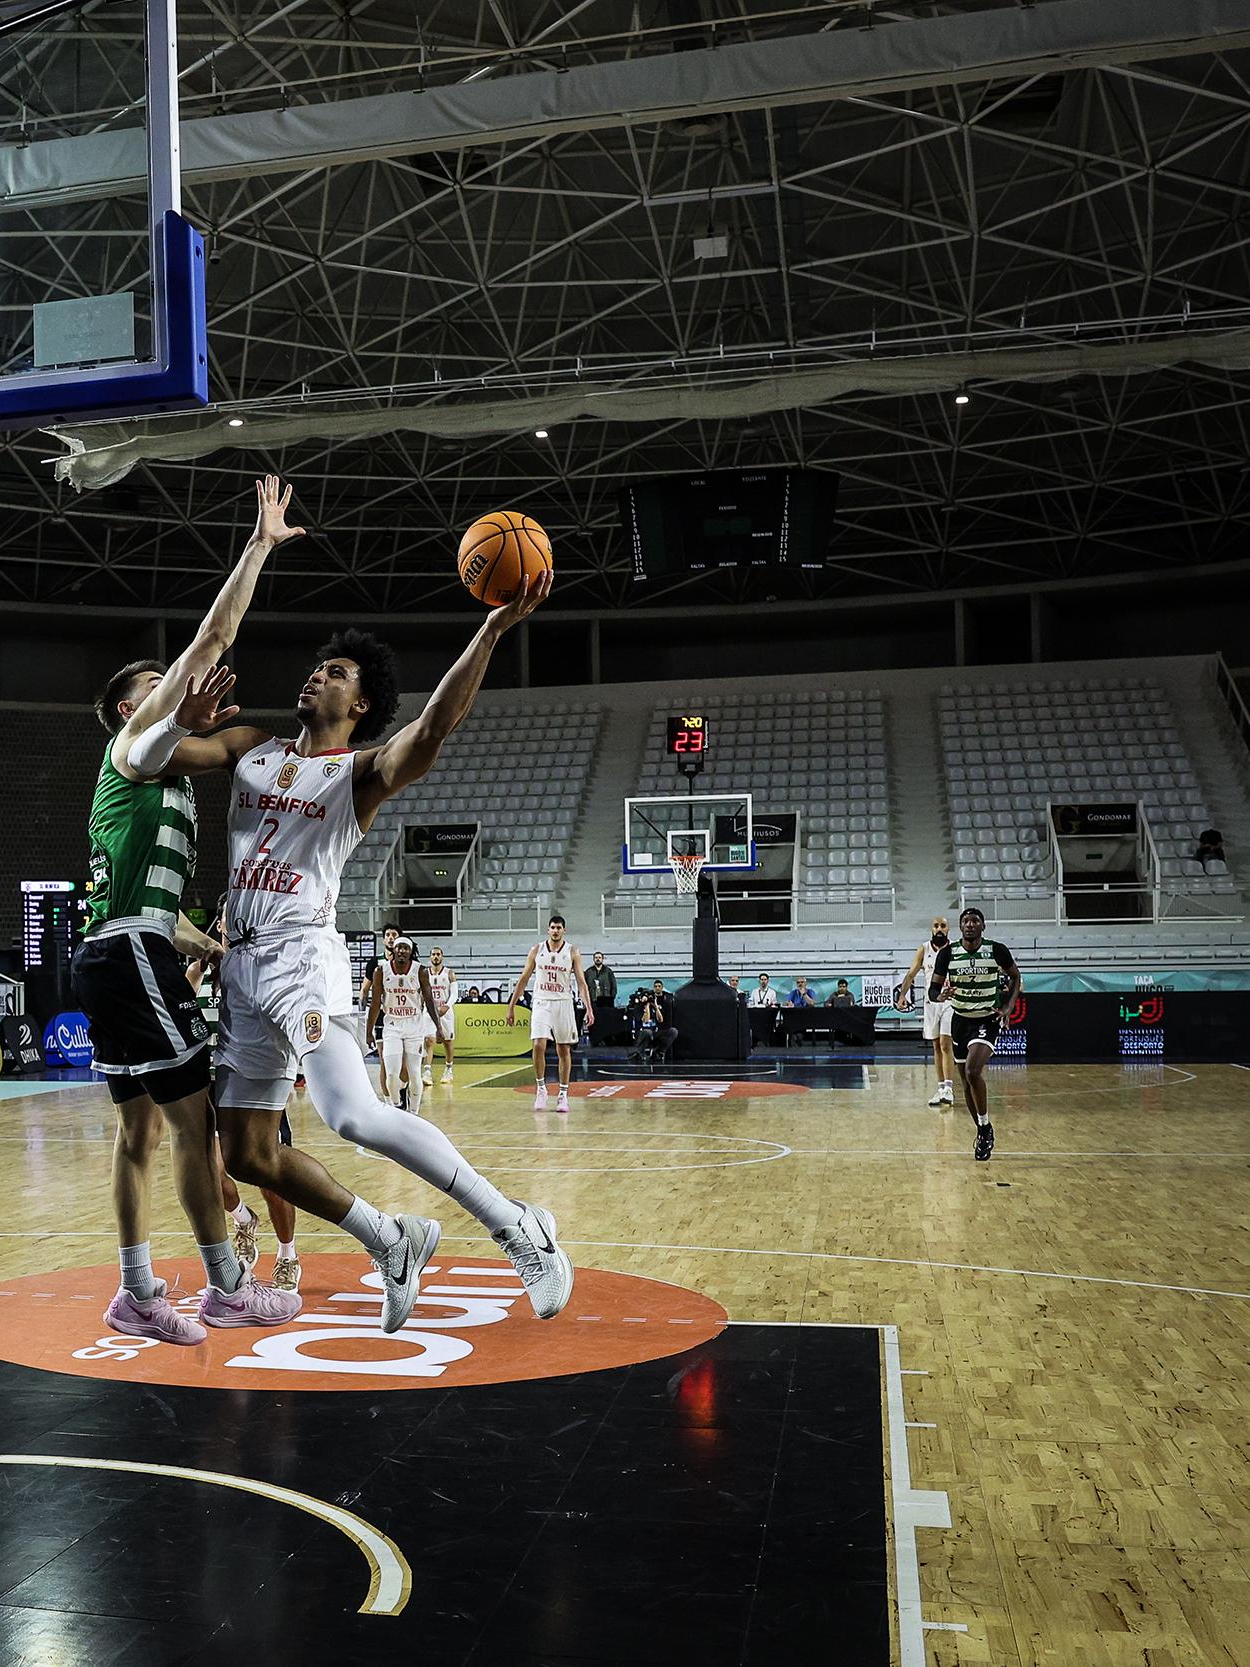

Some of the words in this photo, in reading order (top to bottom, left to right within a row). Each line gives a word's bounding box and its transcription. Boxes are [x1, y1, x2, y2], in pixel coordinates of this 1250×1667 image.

[675, 732, 702, 751] 23
[238, 791, 253, 809] SL
[257, 794, 327, 821] BENFICA
[258, 818, 280, 854] 2
[956, 967, 989, 976] SPORTING
[547, 972, 557, 982] 14
[432, 991, 441, 999] 13
[864, 986, 883, 996] HUGO
[396, 994, 407, 1006] 19
[864, 995, 891, 1006] SANTOS
[978, 1029, 987, 1038] 3
